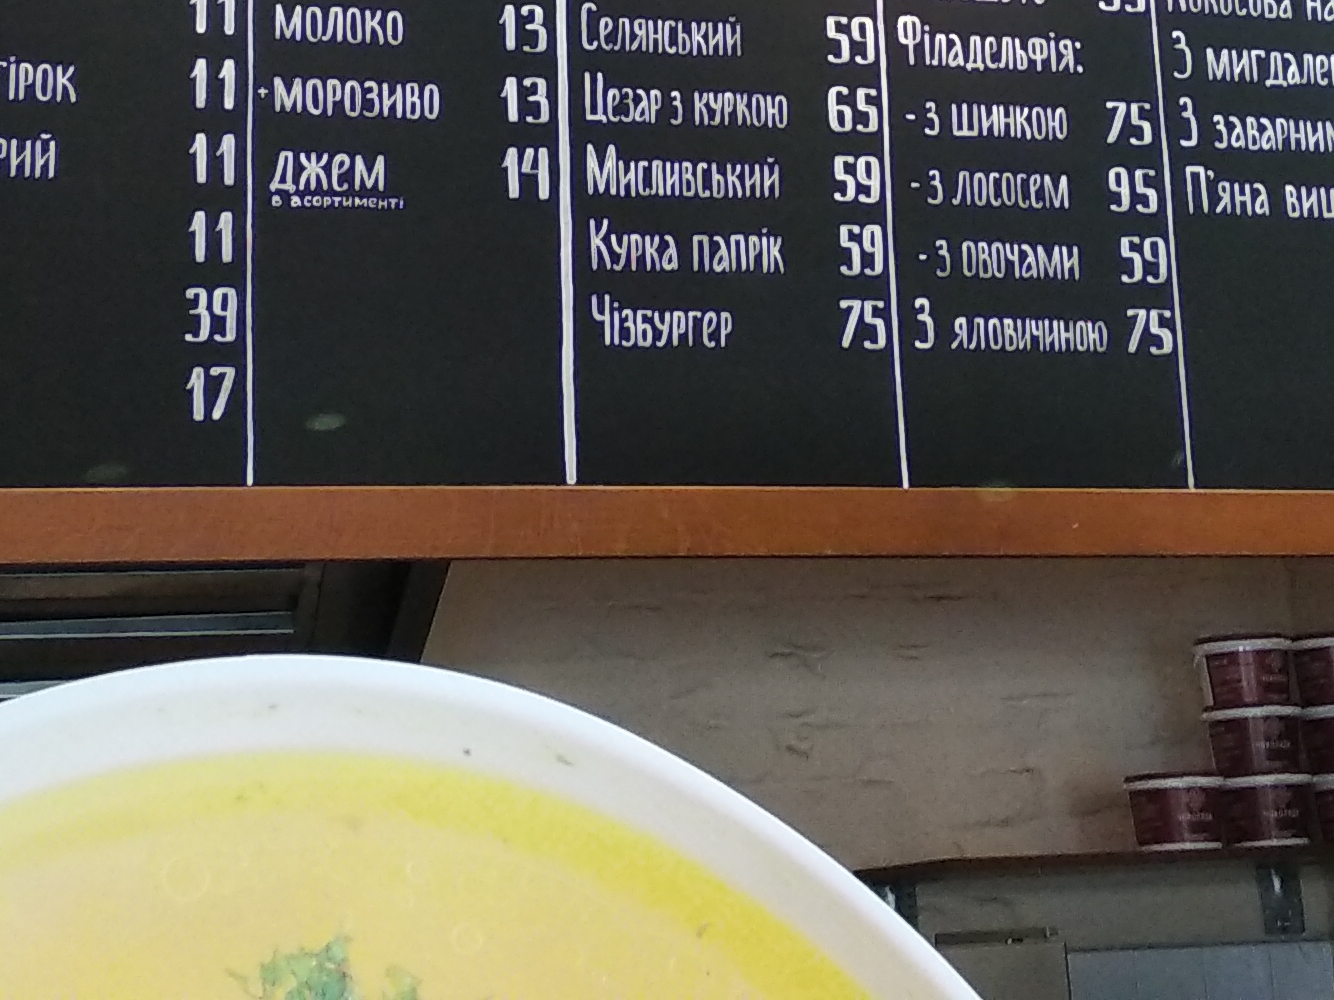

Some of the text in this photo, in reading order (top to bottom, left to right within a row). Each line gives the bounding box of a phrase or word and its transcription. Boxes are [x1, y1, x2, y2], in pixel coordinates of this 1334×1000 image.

[275, 3, 547, 52] молоко 13
[581, 2, 875, 64] Селянський 59
[897, 15, 1083, 73] Філадельфія:
[190, 58, 235, 110] 11
[500, 77, 549, 123] 13
[584, 71, 661, 124] Цезар
[694, 91, 787, 128] куркою
[828, 86, 878, 132] 65
[952, 103, 1067, 140] шинкою
[1106, 101, 1152, 145] 75
[189, 133, 235, 186] 11
[269, 147, 549, 200] джем 14
[587, 143, 880, 203] Мисливський 59
[952, 171, 1069, 209] лососем
[1109, 167, 1157, 213] 95
[1185, 166, 1269, 216] П'яна
[189, 211, 232, 263] 11
[590, 218, 883, 276] Курка папрік 59
[962, 241, 1079, 280] овочами
[1121, 236, 1167, 284] 59
[185, 287, 237, 342] 39
[591, 294, 886, 349] Чізбургер 75
[951, 317, 1107, 352] яловичиною
[1127, 305, 1175, 355] 75
[186, 367, 235, 421] 17
